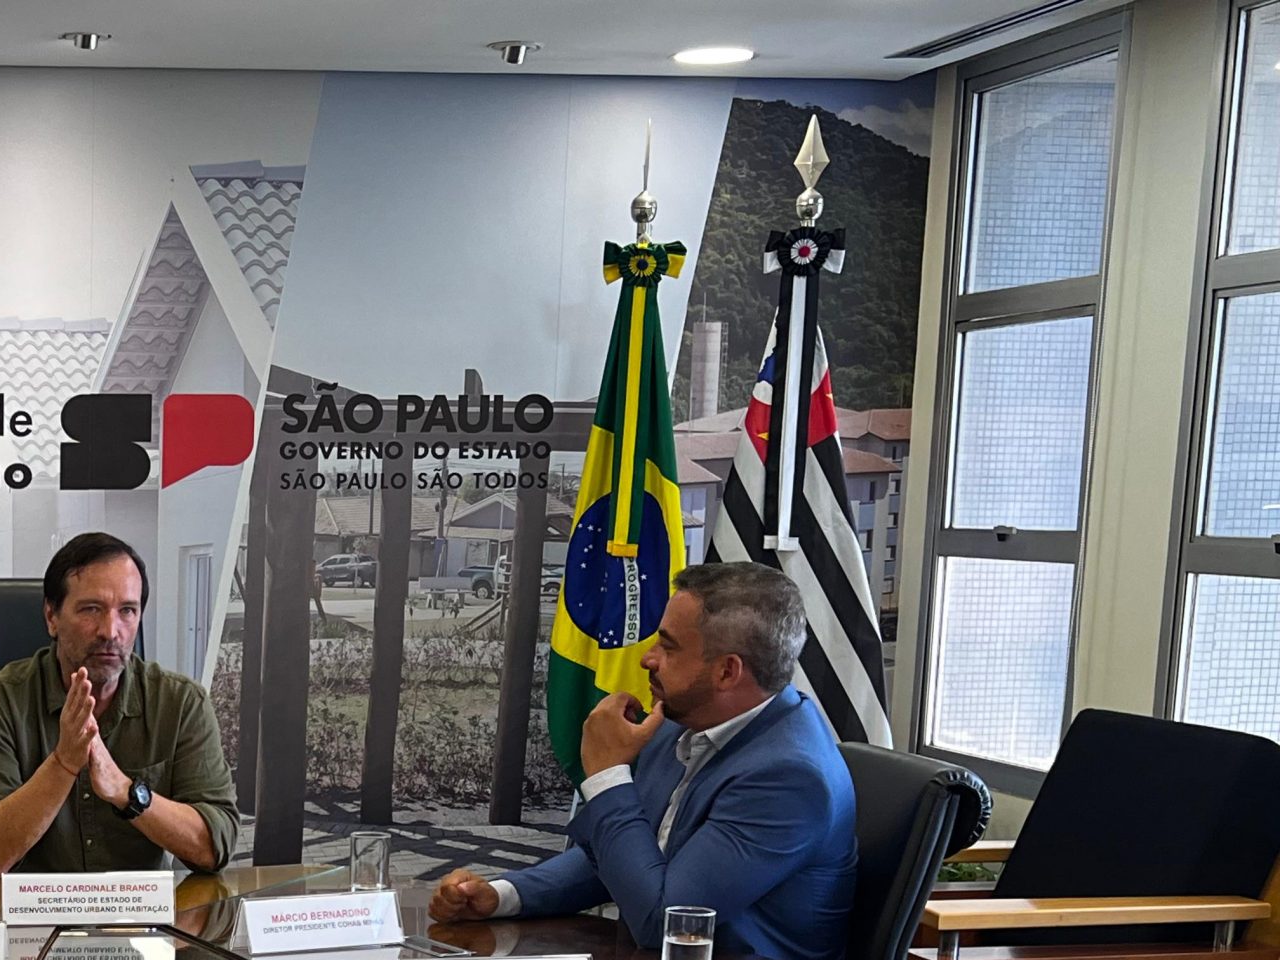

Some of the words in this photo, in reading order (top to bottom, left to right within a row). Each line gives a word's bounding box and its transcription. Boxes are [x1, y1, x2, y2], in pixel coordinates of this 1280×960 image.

[281, 382, 384, 435] SÃO
[397, 393, 554, 434] PAULO
[279, 440, 404, 461] GOVERNO
[414, 440, 449, 460] DO
[458, 440, 552, 460] ESTADO
[279, 468, 327, 491] SÃO
[335, 472, 407, 491] PAULO
[416, 468, 463, 491] SÃO
[474, 472, 549, 491] TODOS
[626, 558, 638, 640] PROGRESSO
[19, 884, 63, 893] MARCELO
[65, 884, 117, 893] CARDINALE
[119, 884, 158, 892] BRANCO
[38, 896, 86, 904] SECRETÁRIO
[8, 906, 83, 914] DESENVOLVIMENTO
[125, 904, 169, 914] HABITAÇÃO
[310, 908, 370, 920] BERNARDINO
[263, 926, 293, 934] DIRETOR
[294, 923, 336, 931] PRESIDENTE
